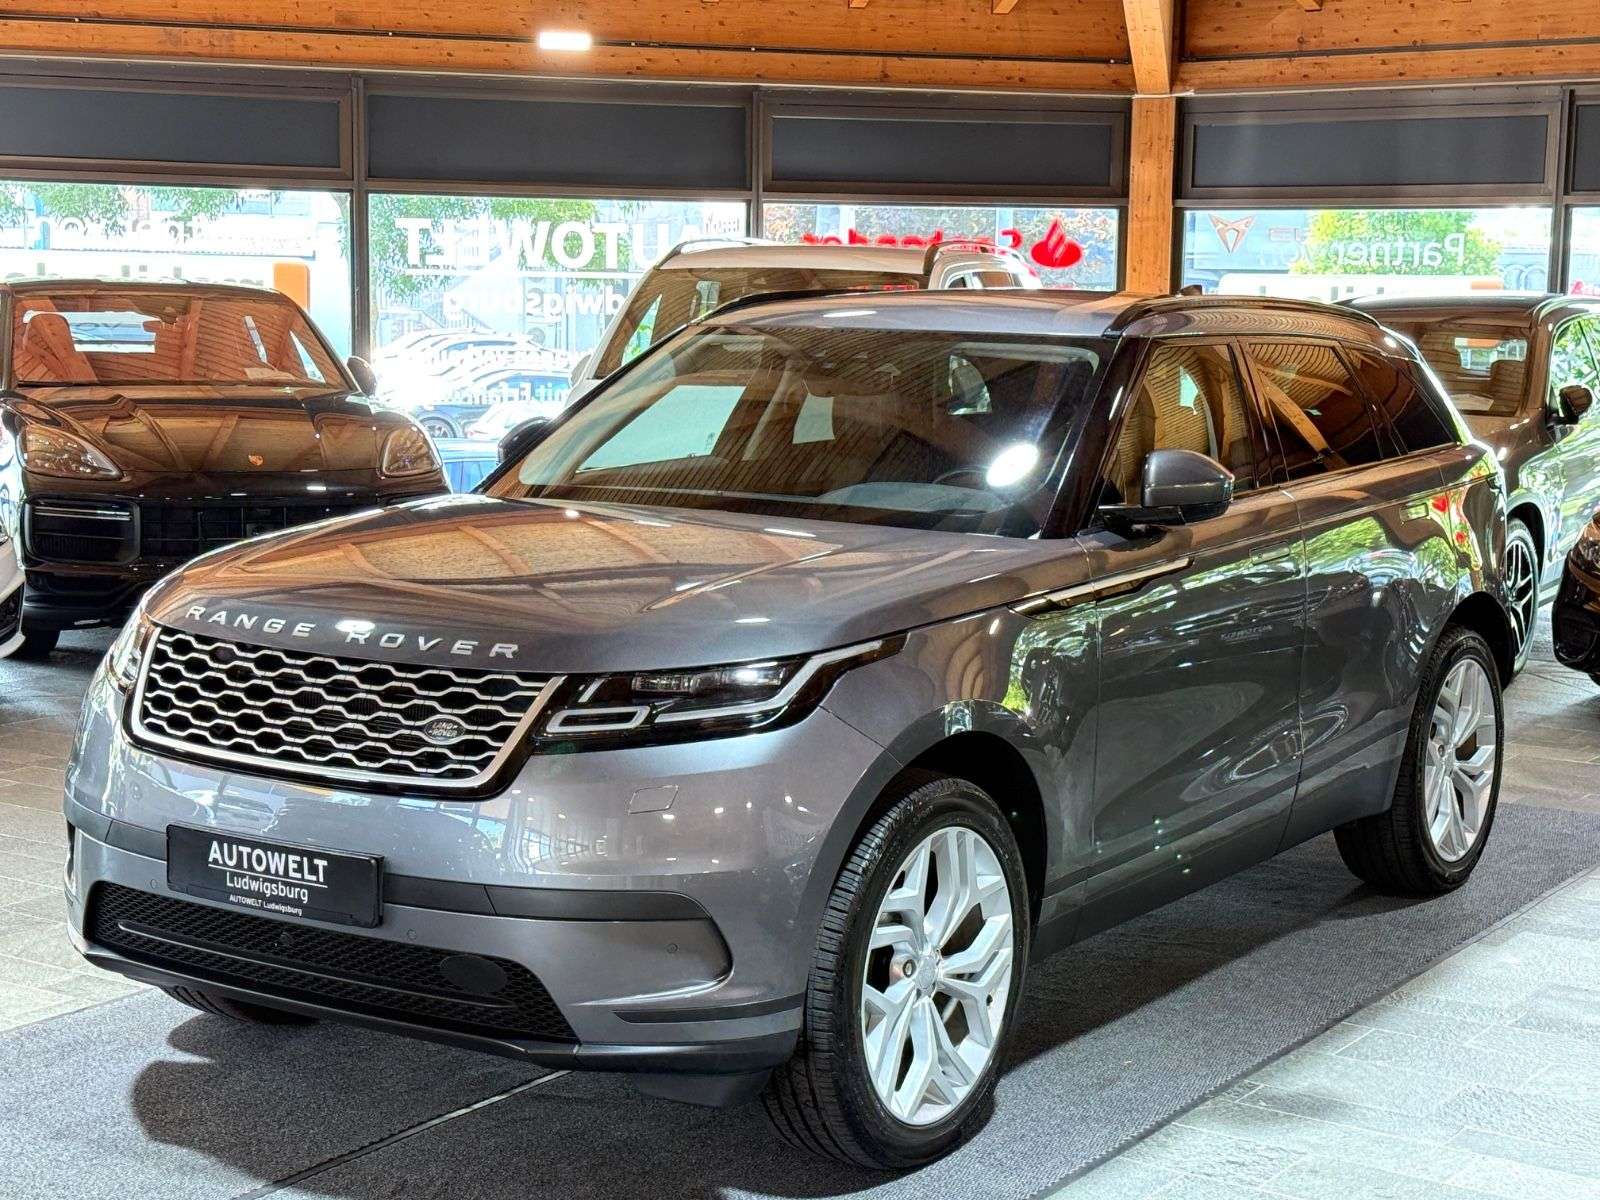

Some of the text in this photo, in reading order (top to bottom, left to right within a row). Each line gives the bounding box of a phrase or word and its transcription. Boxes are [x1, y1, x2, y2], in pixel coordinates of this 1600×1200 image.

[185, 605, 519, 659] RANGE ROVER
[208, 840, 328, 883] AUTOWELT
[226, 872, 308, 903] Ludwigsburg
[229, 894, 302, 916] AUTOWELT Ludwigsburg
